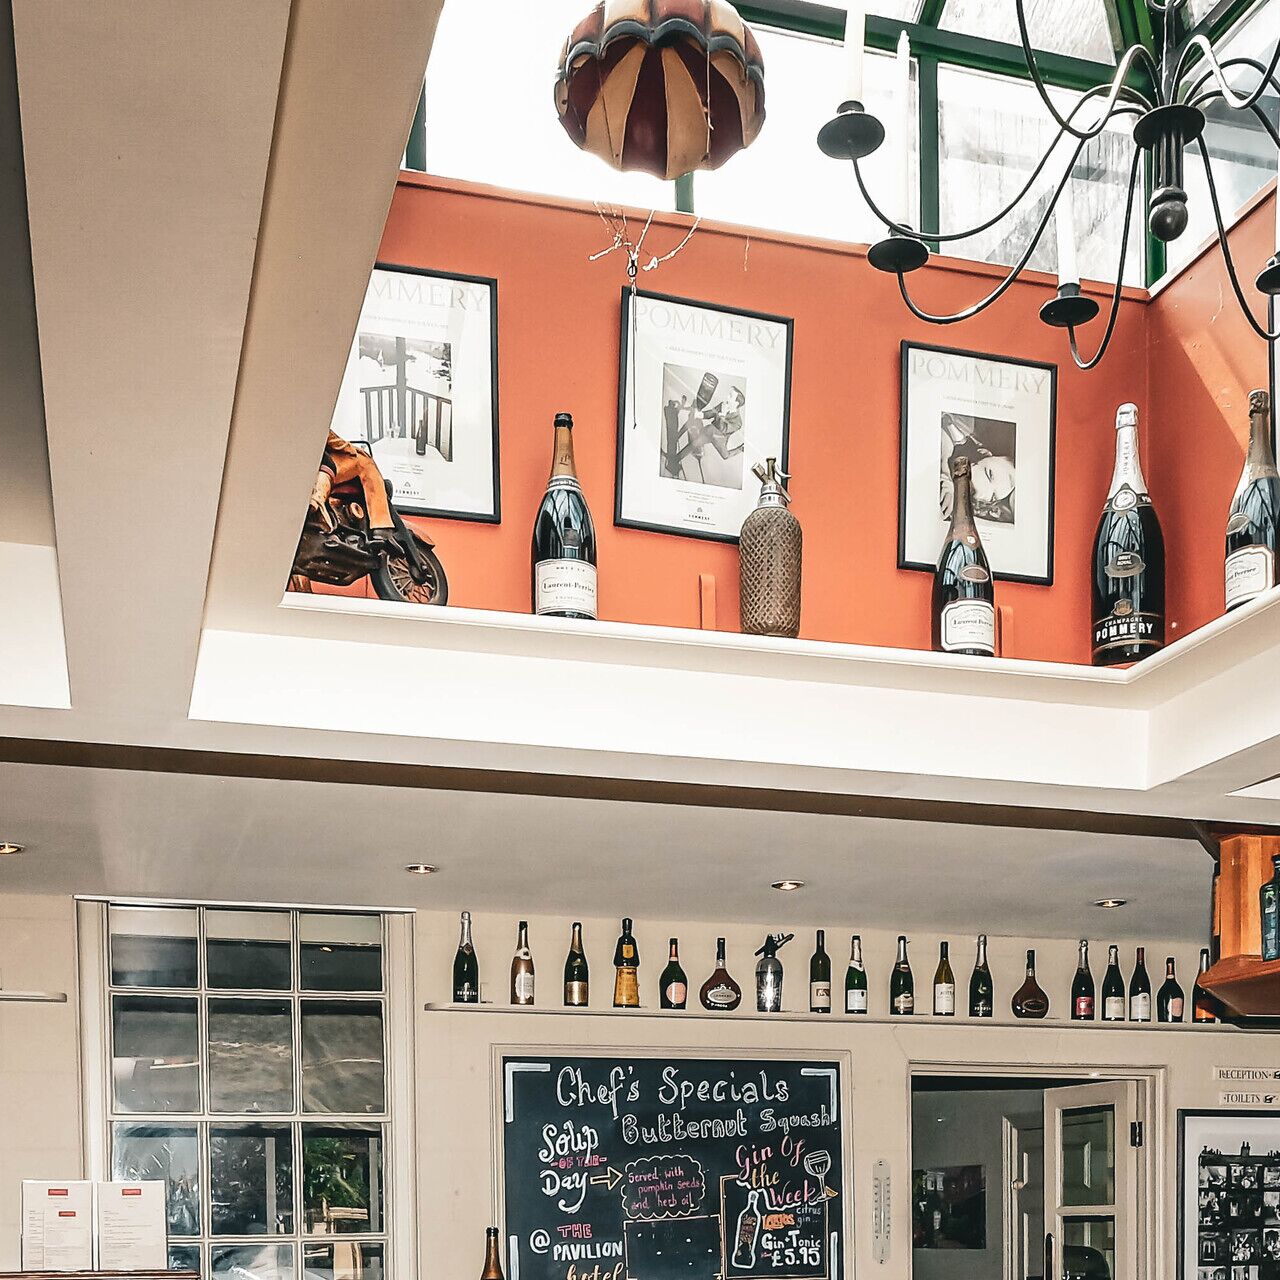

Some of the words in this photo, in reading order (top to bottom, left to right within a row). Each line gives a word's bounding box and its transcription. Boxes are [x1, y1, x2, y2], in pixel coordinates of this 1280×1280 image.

[369, 277, 488, 312] MMERY
[912, 353, 1047, 394] POMMERY
[1096, 622, 1153, 642] POMMERY
[1105, 616, 1142, 628] CHAMPAGNE
[1219, 1069, 1269, 1081] RECEPTION
[556, 1065, 641, 1121] Chef's
[658, 1066, 790, 1110] Specials
[1225, 1093, 1261, 1104] TOILETS
[621, 1108, 747, 1144] Butternut
[760, 1104, 830, 1135] Squash
[538, 1119, 599, 1165] Soup
[736, 1144, 773, 1181] Gin
[781, 1135, 806, 1167] Of
[628, 1167, 659, 1183] Served
[664, 1165, 684, 1179] with
[752, 1163, 780, 1189] the
[539, 1169, 588, 1214] Day
[638, 1182, 674, 1199] pumpkin
[770, 1179, 816, 1206] Week
[631, 1197, 649, 1210] and
[657, 1194, 678, 1207] herb
[796, 1203, 821, 1215] citrus
[557, 1223, 593, 1240] THE
[761, 1232, 785, 1249] Gin
[788, 1229, 821, 1248] Tonic
[553, 1240, 623, 1262] PAVILION
[772, 1247, 821, 1268] £5.95
